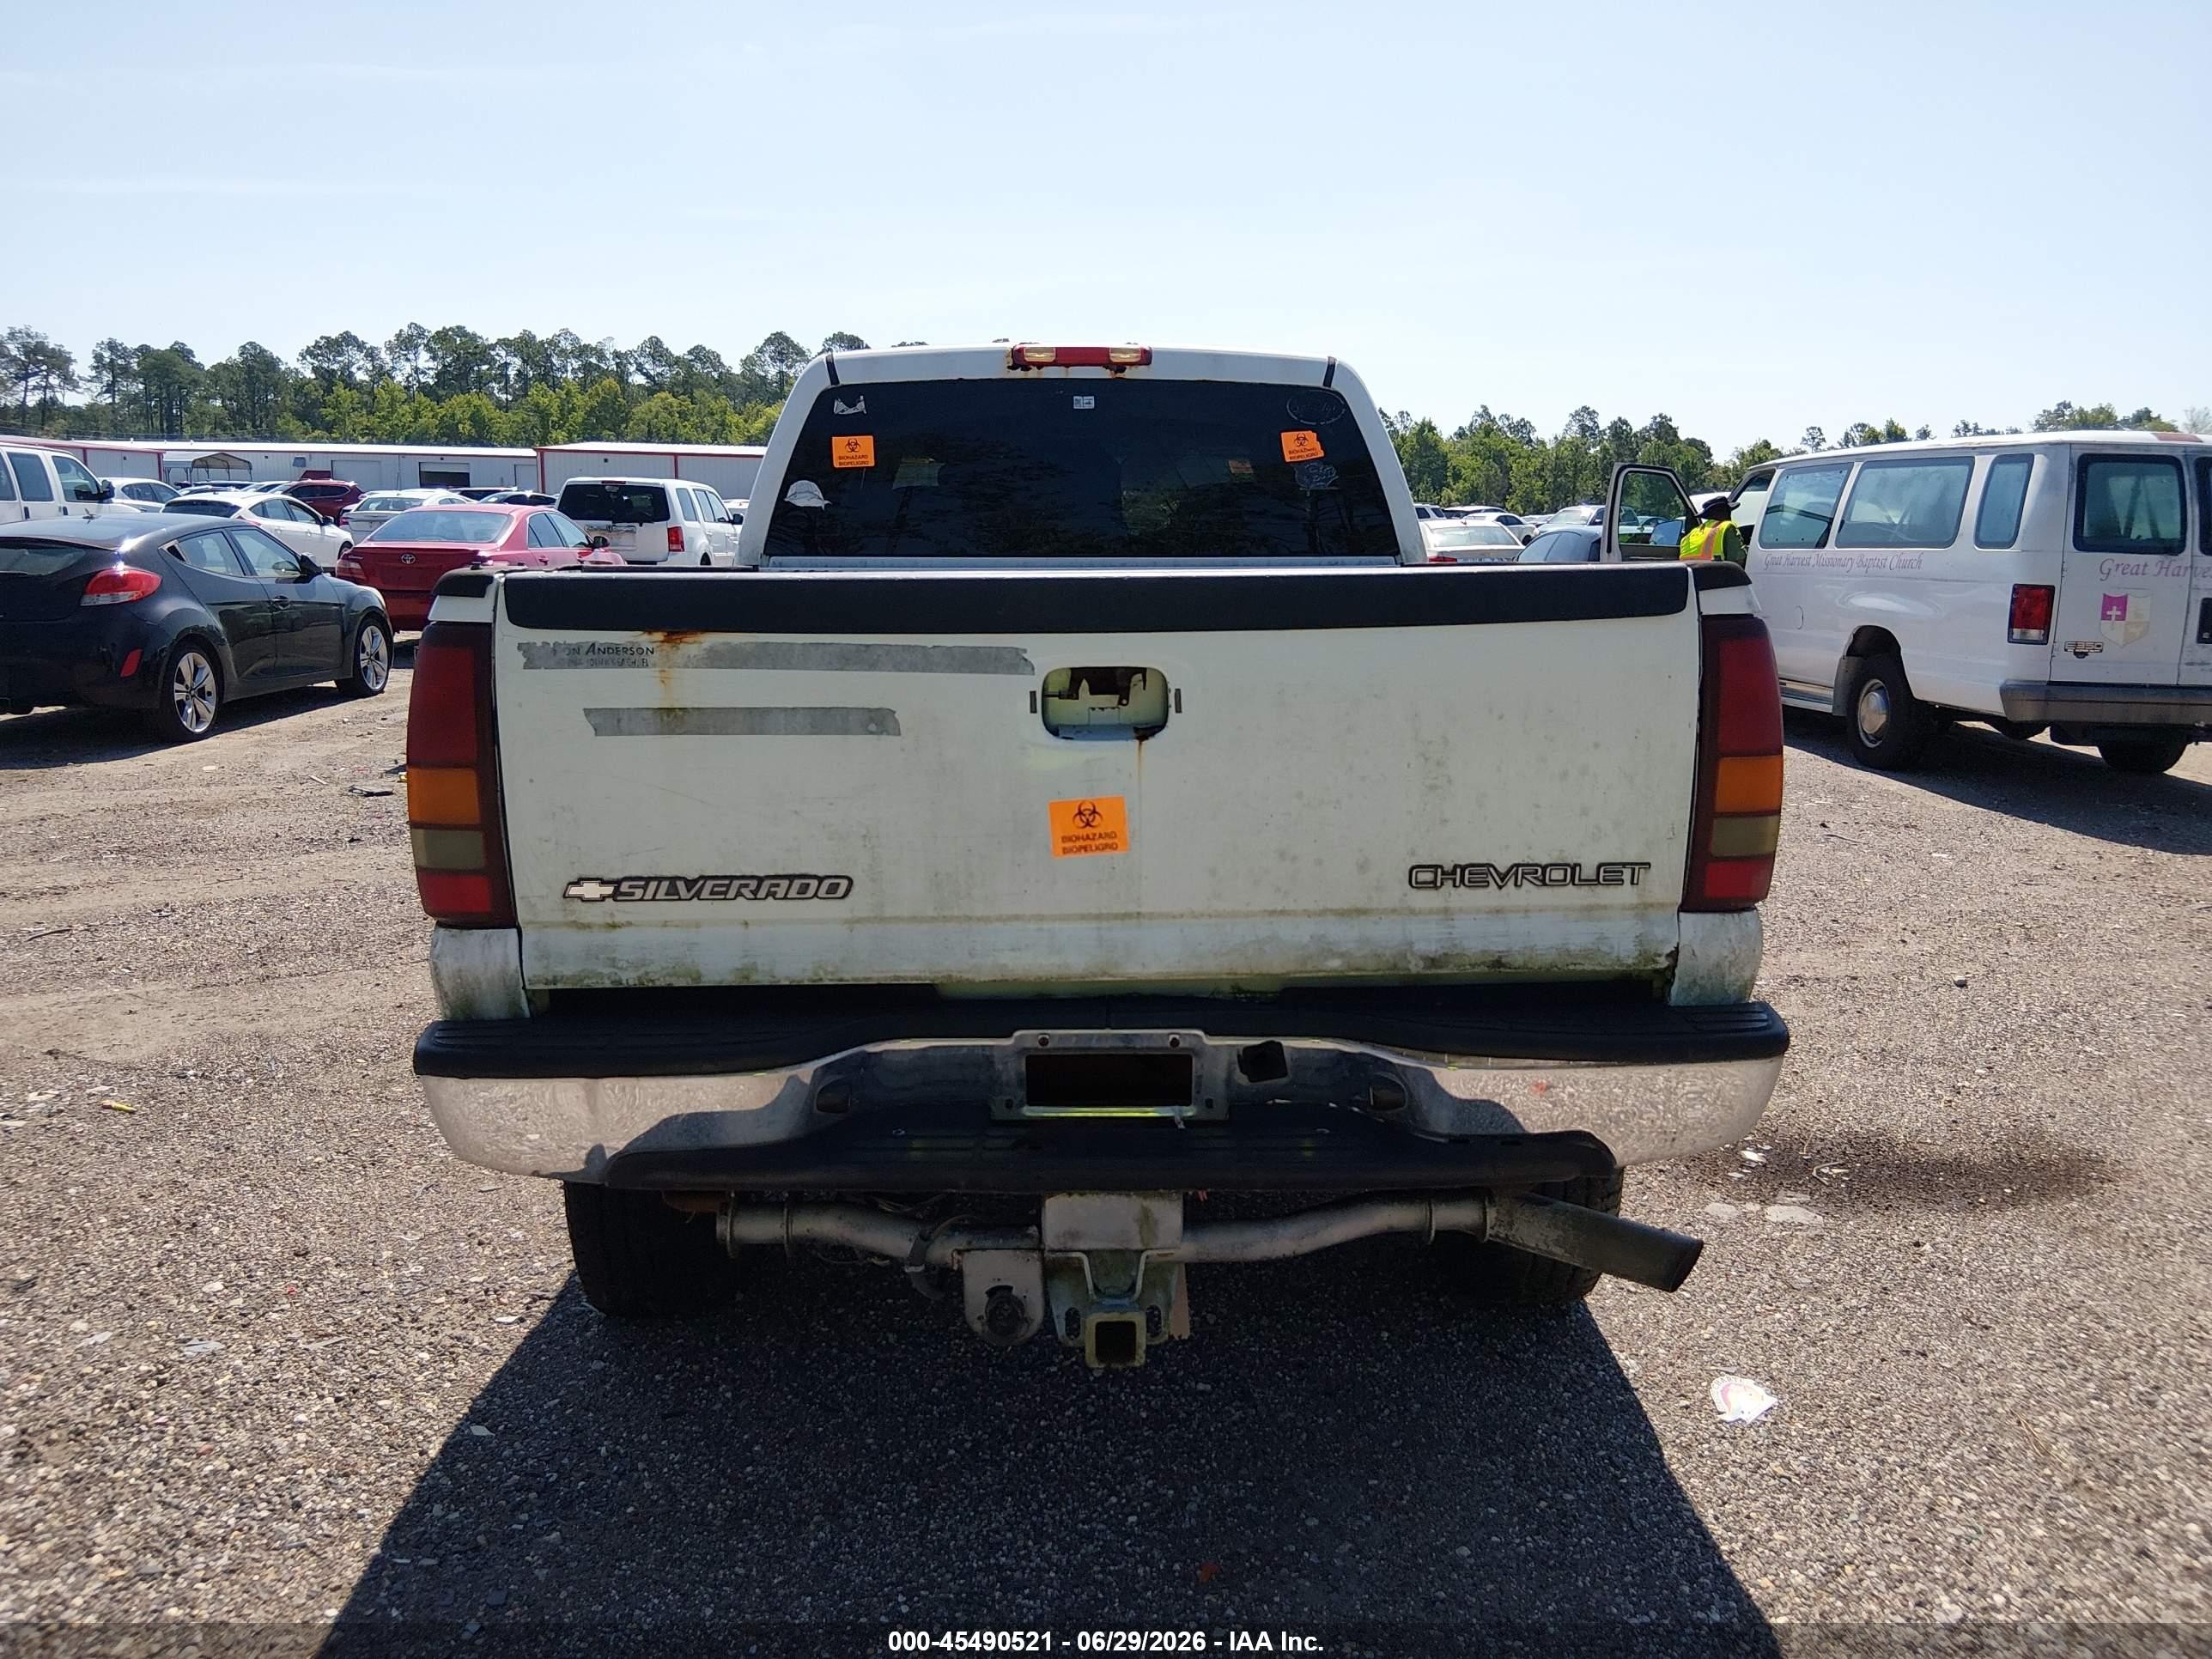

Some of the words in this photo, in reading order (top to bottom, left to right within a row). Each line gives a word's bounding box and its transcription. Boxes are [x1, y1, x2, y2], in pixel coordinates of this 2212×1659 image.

[1764, 554, 1783, 570] Great
[1783, 552, 1812, 568] Harvest
[1812, 552, 1854, 573] Missionary
[1855, 553, 1887, 574] Baptist
[1888, 552, 1924, 571] Church
[2100, 558, 2151, 581] Great
[2153, 558, 2212, 578] Harve
[586, 642, 654, 656] ANDERSON
[1060, 831, 1117, 843] BIOHAZARD
[1062, 842, 1118, 855] BIOPELIGRO
[1409, 862, 1650, 889] CHEVROLET
[614, 877, 853, 901] SILVERADO
